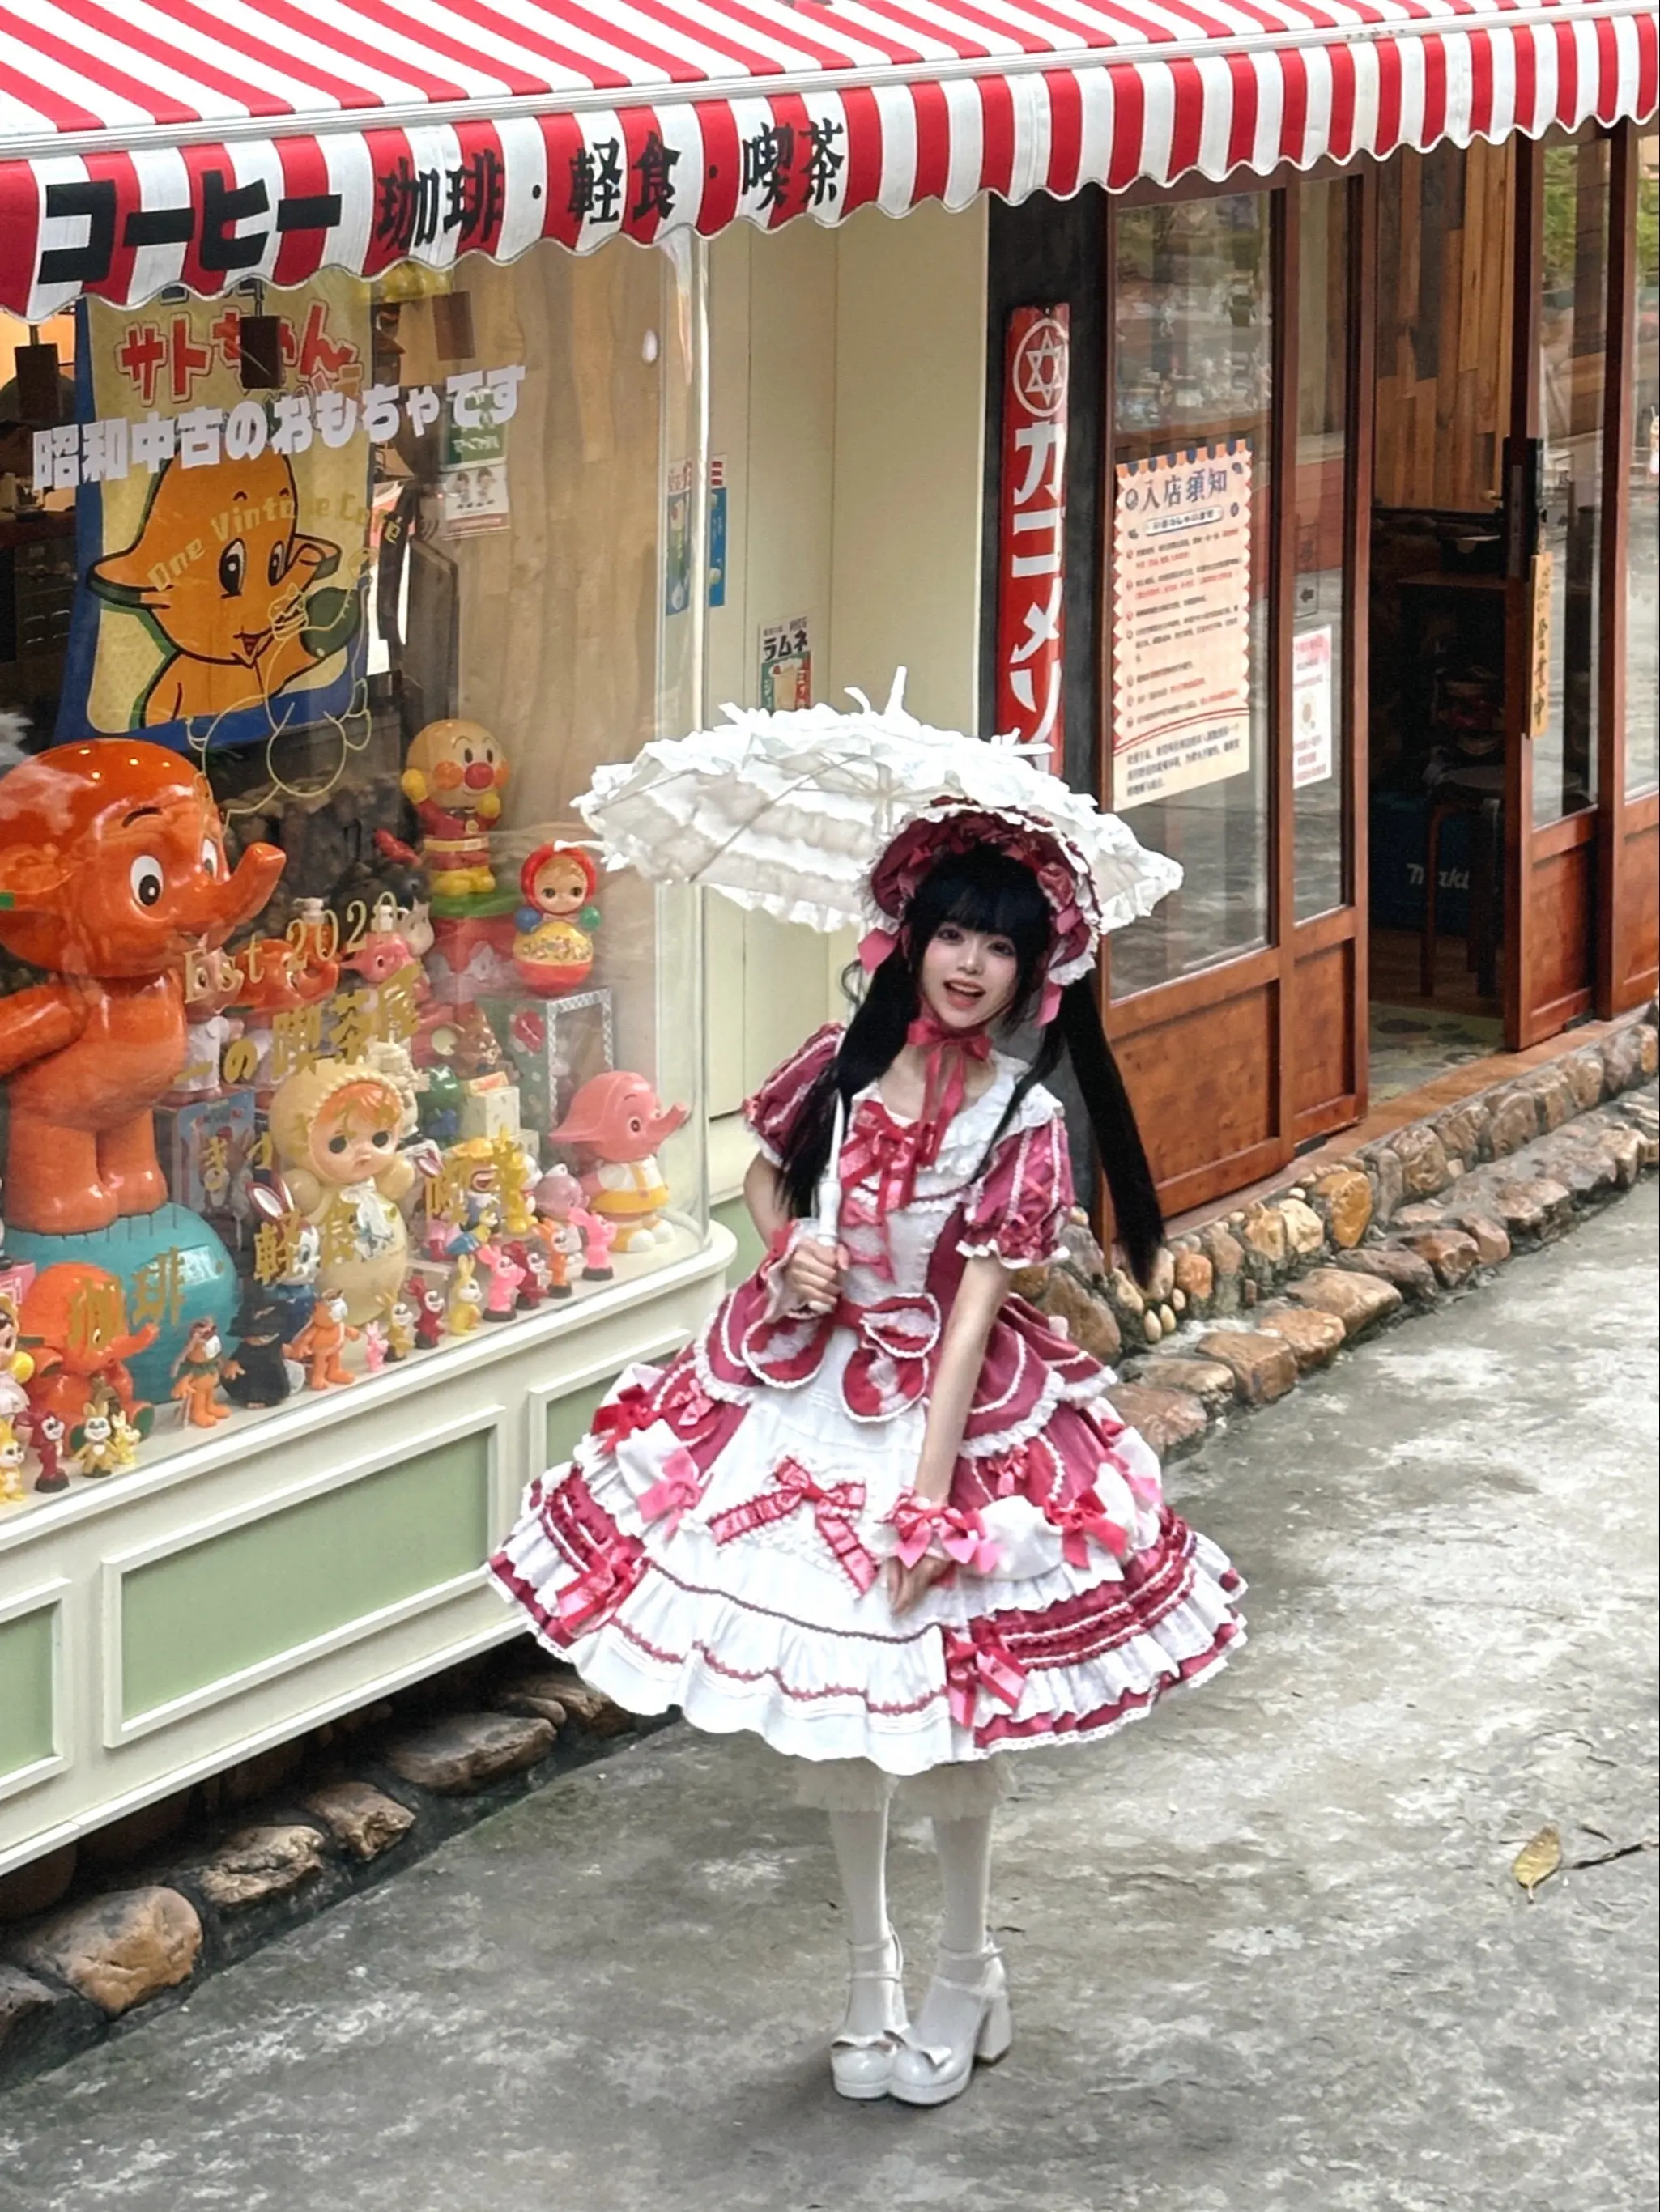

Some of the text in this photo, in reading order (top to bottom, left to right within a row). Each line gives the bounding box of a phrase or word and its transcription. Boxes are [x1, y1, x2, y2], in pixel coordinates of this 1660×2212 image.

[37, 169, 343, 285] コーヒー
[32, 366, 526, 487] 昭和中古のおもちゃです
[147, 538, 205, 593] One
[763, 629, 808, 662] ラムネ
[183, 932, 265, 1005] Est
